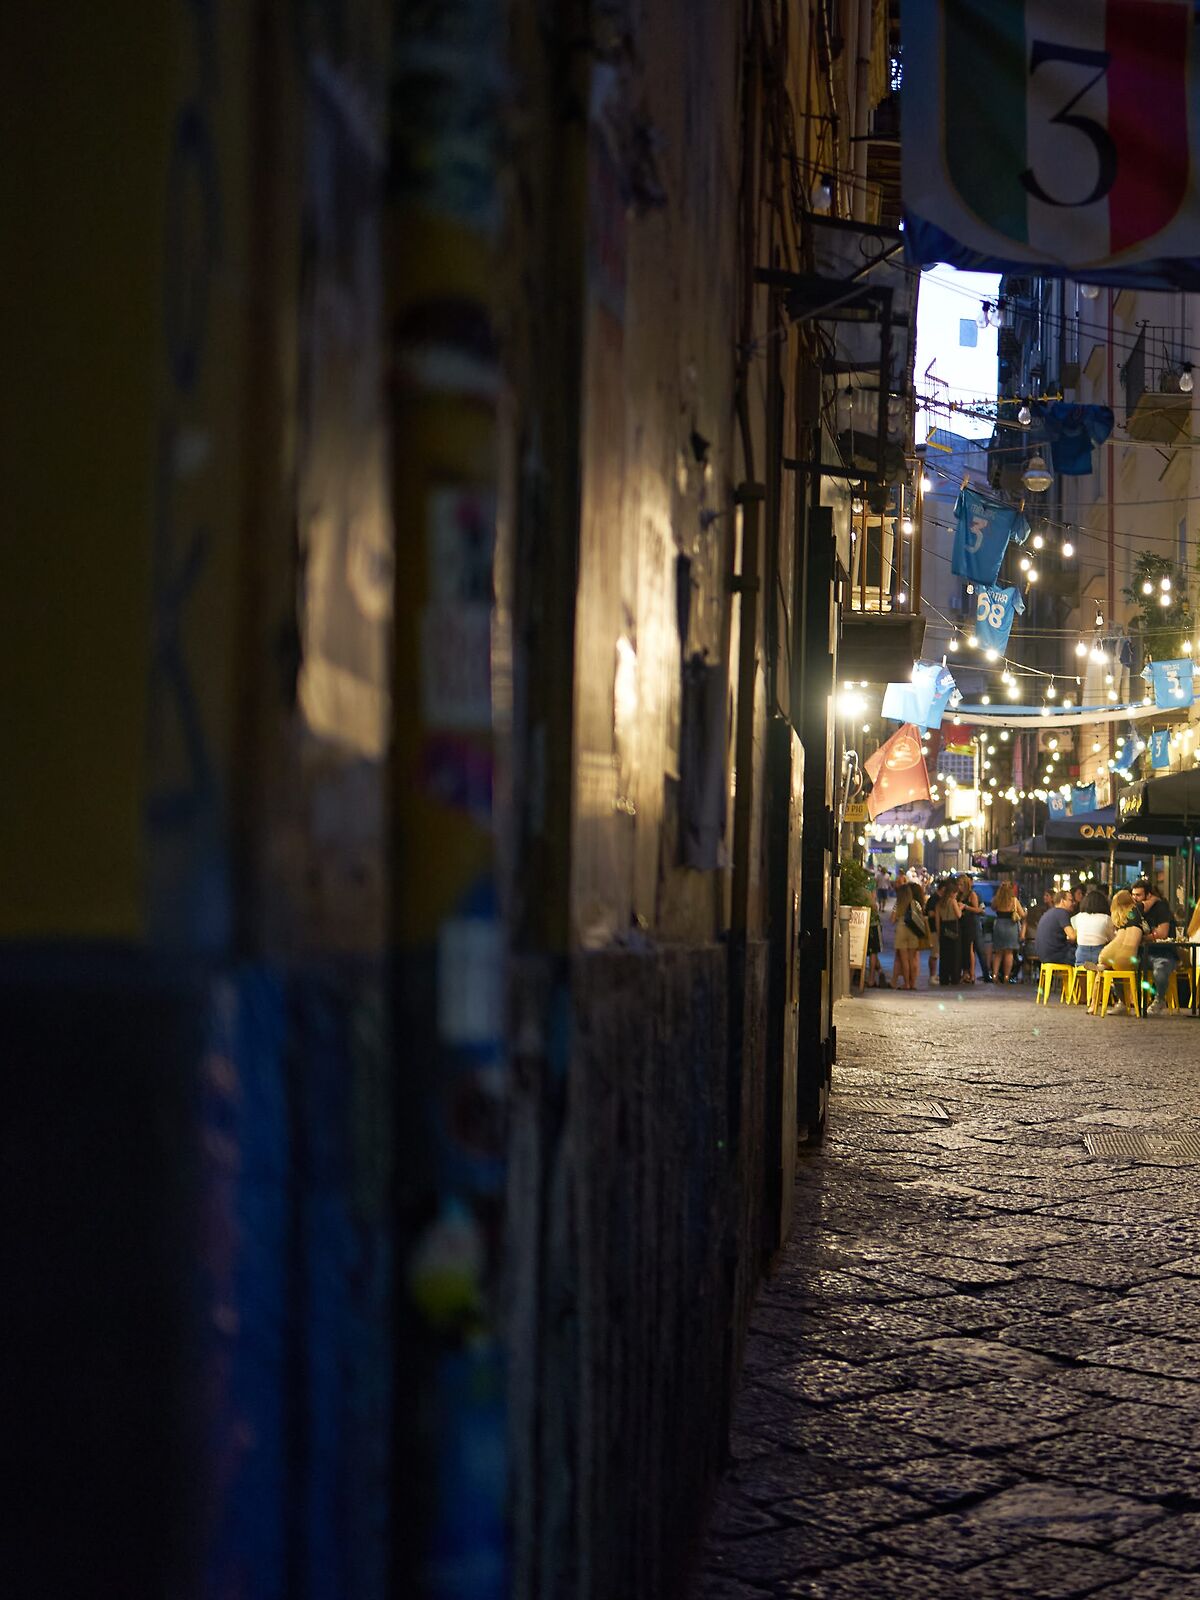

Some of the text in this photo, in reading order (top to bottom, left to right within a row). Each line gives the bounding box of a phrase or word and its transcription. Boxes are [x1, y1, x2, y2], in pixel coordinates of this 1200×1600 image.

[1018, 40, 1118, 207] 3
[965, 516, 989, 554] 3
[977, 592, 1005, 628] 68
[1166, 671, 1182, 694] 3
[851, 804, 863, 813] PIG
[1080, 824, 1117, 839] OAK
